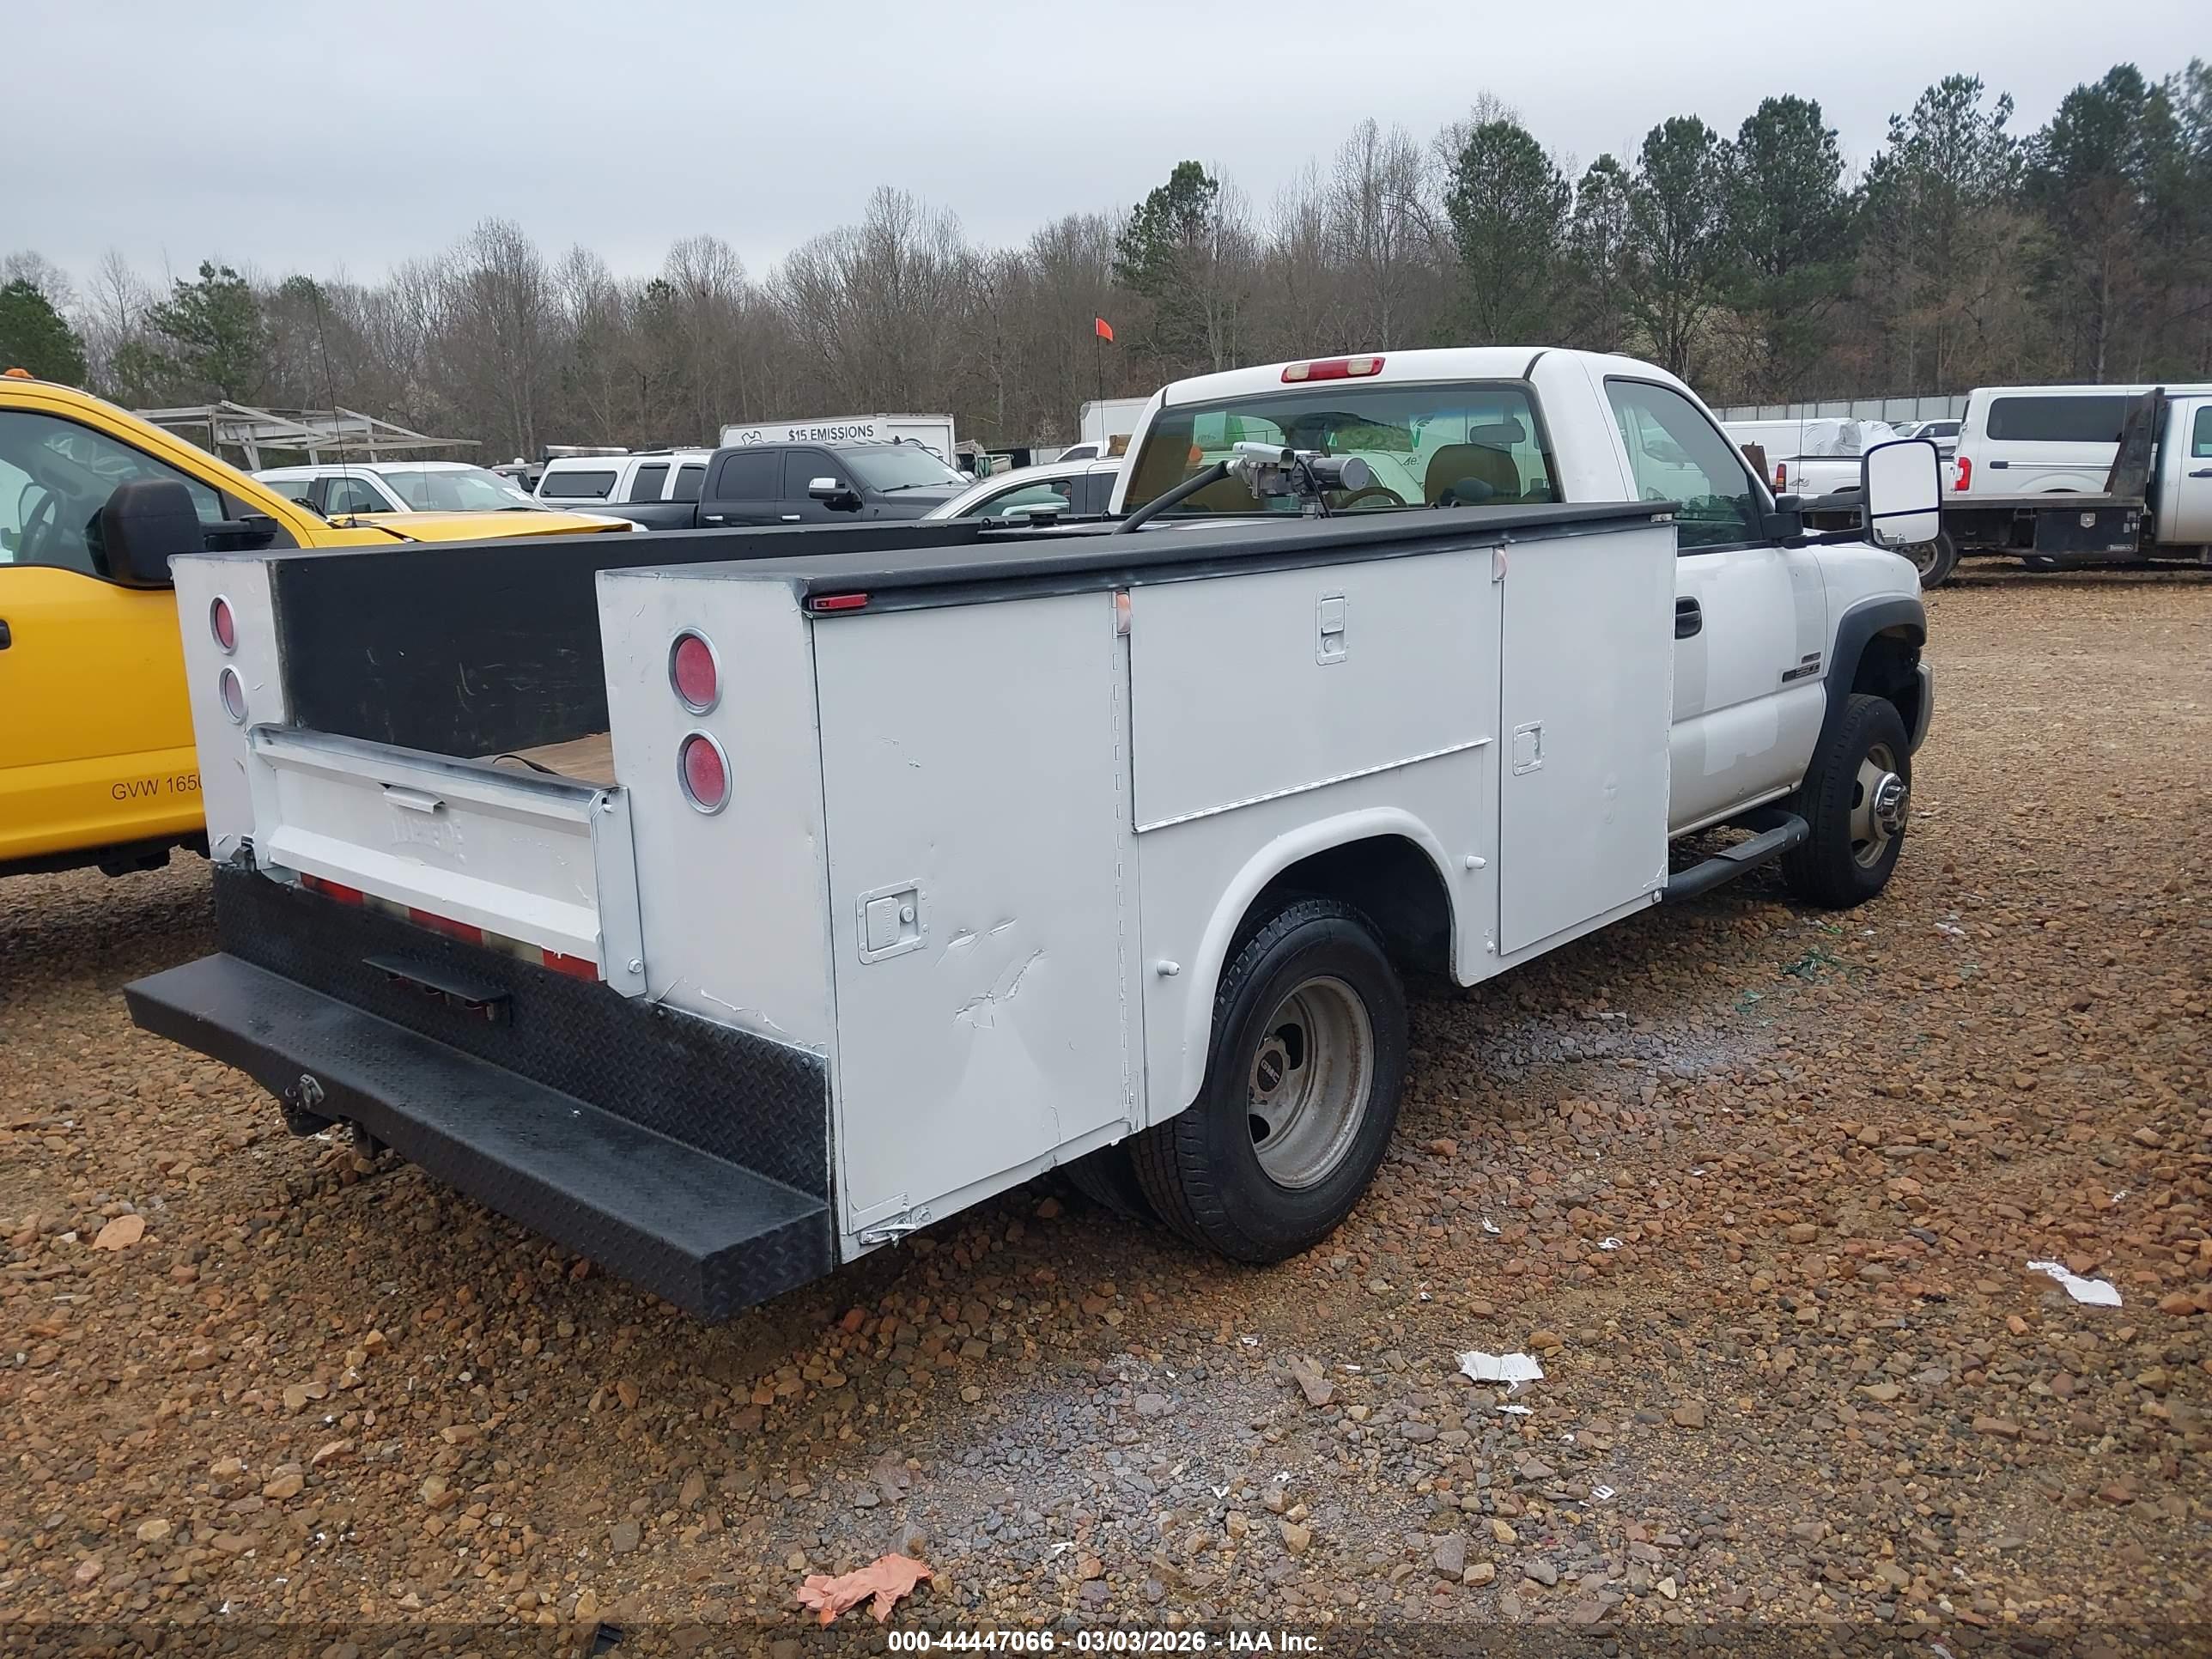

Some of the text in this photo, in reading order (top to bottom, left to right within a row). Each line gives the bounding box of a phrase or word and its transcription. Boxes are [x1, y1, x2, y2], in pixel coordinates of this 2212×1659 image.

[788, 425, 874, 441] $15 EMISSIONS
[112, 779, 159, 800] GVW
[1261, 1058, 1280, 1084] GMC
